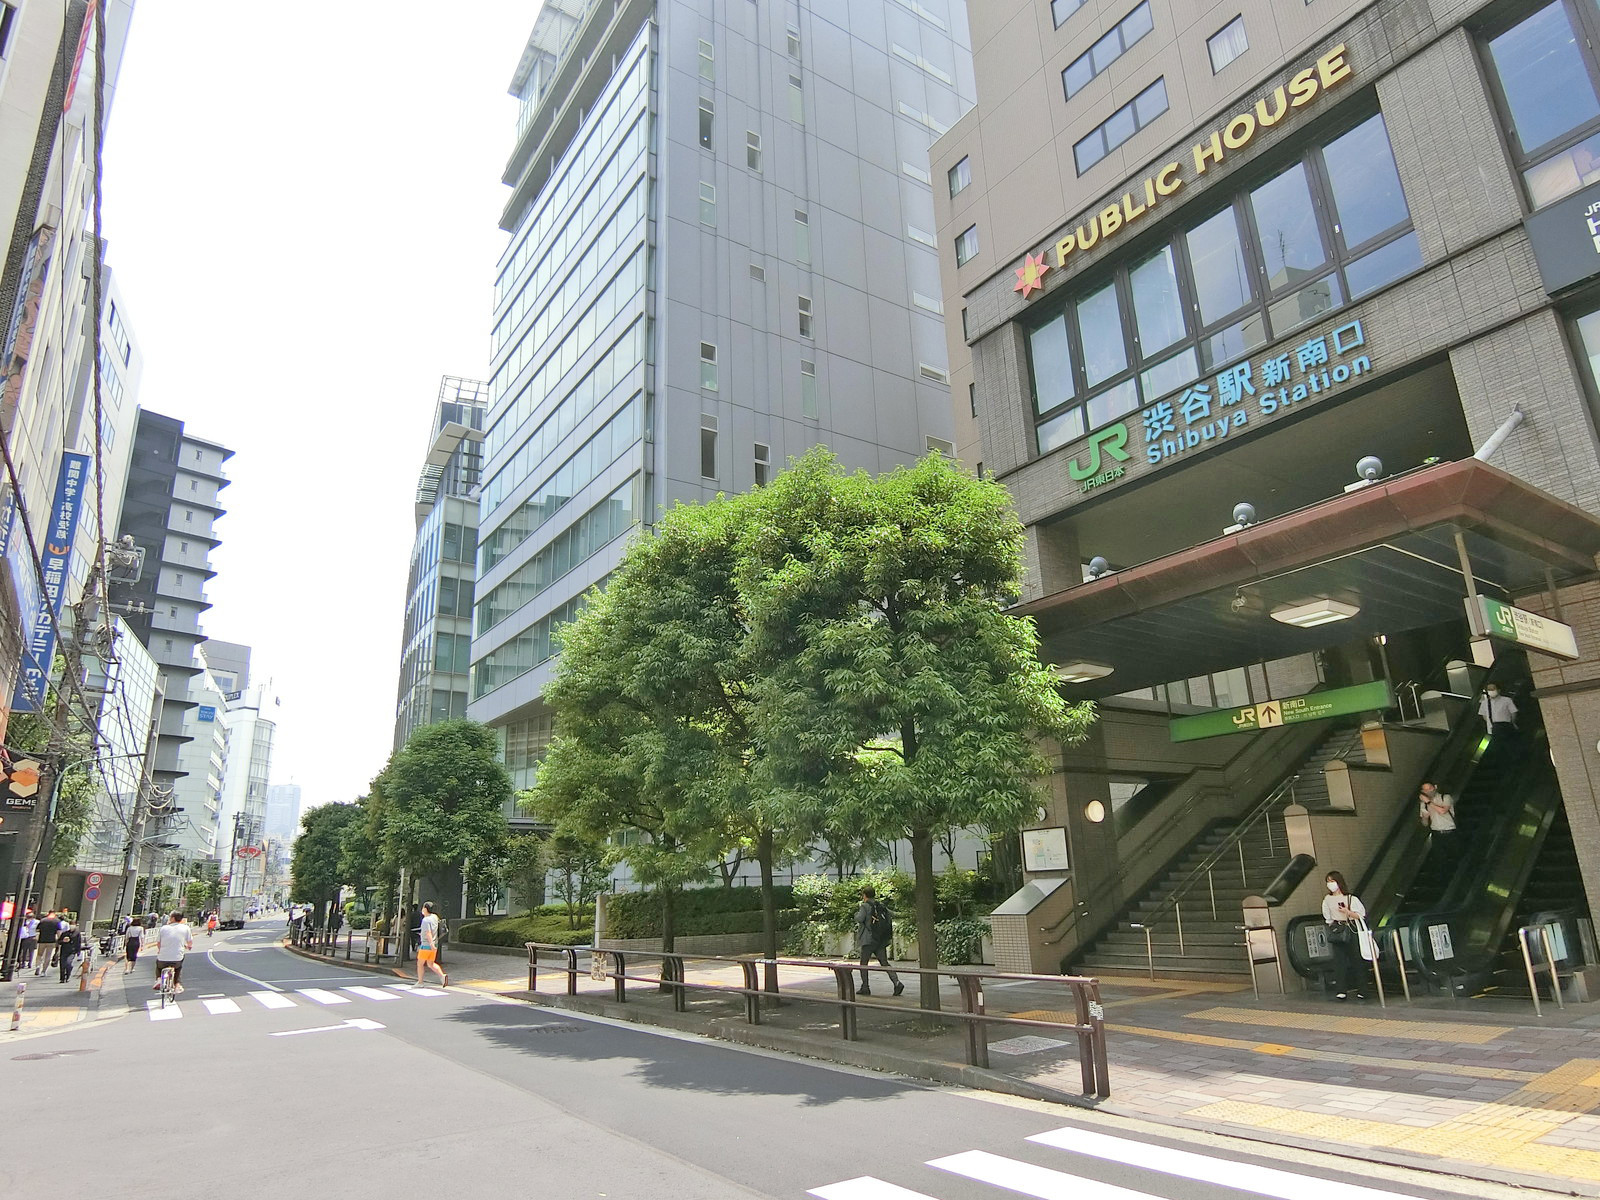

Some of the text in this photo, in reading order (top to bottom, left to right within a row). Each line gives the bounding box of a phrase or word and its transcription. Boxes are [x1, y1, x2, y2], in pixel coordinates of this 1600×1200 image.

[1056, 42, 1352, 268] PUBLIC HOUSE
[1142, 319, 1366, 442] 渋谷駅新南口
[1146, 354, 1371, 464] Shibuya Station
[1069, 423, 1131, 480] JR
[1078, 466, 1125, 493] JR東日本
[1496, 605, 1514, 628] JR
[1232, 707, 1256, 724] JR
[1310, 703, 1333, 712] Entrance
